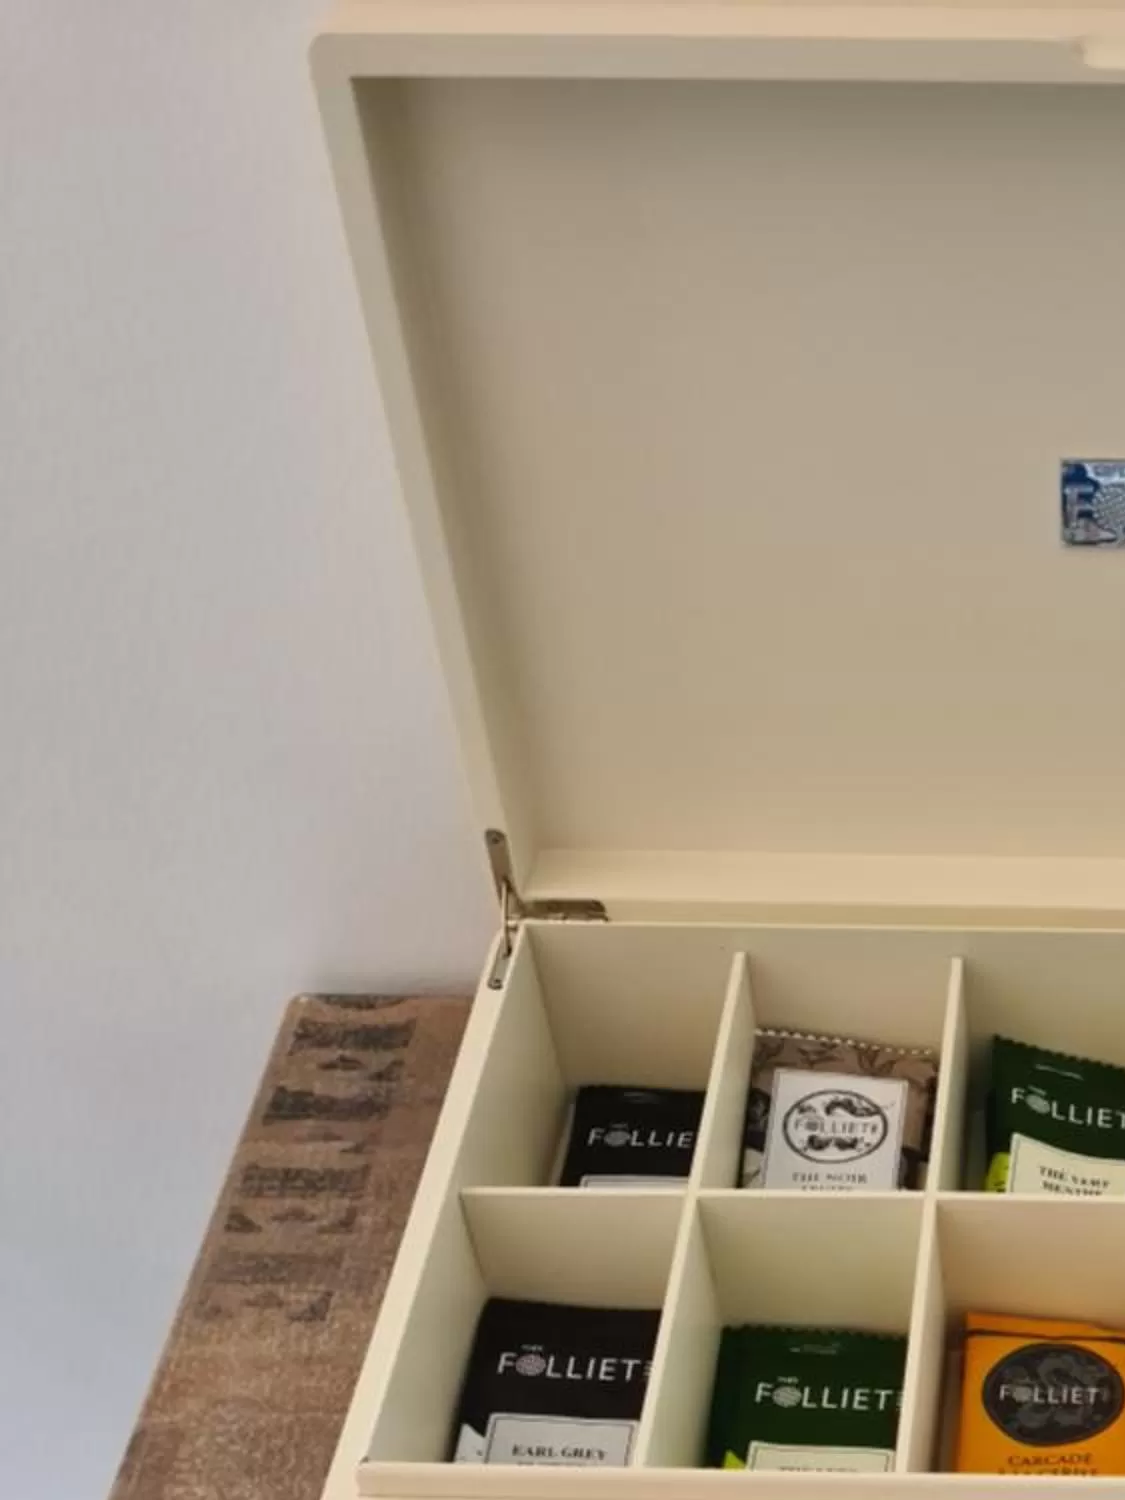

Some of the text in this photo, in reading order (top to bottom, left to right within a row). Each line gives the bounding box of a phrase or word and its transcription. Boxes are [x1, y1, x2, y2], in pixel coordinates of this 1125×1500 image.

[587, 1126, 693, 1148] FOLLIE
[497, 1351, 642, 1382] FOLLIET
[755, 1382, 893, 1411] FOLLIET
[999, 1383, 1099, 1405] FOLLIET
